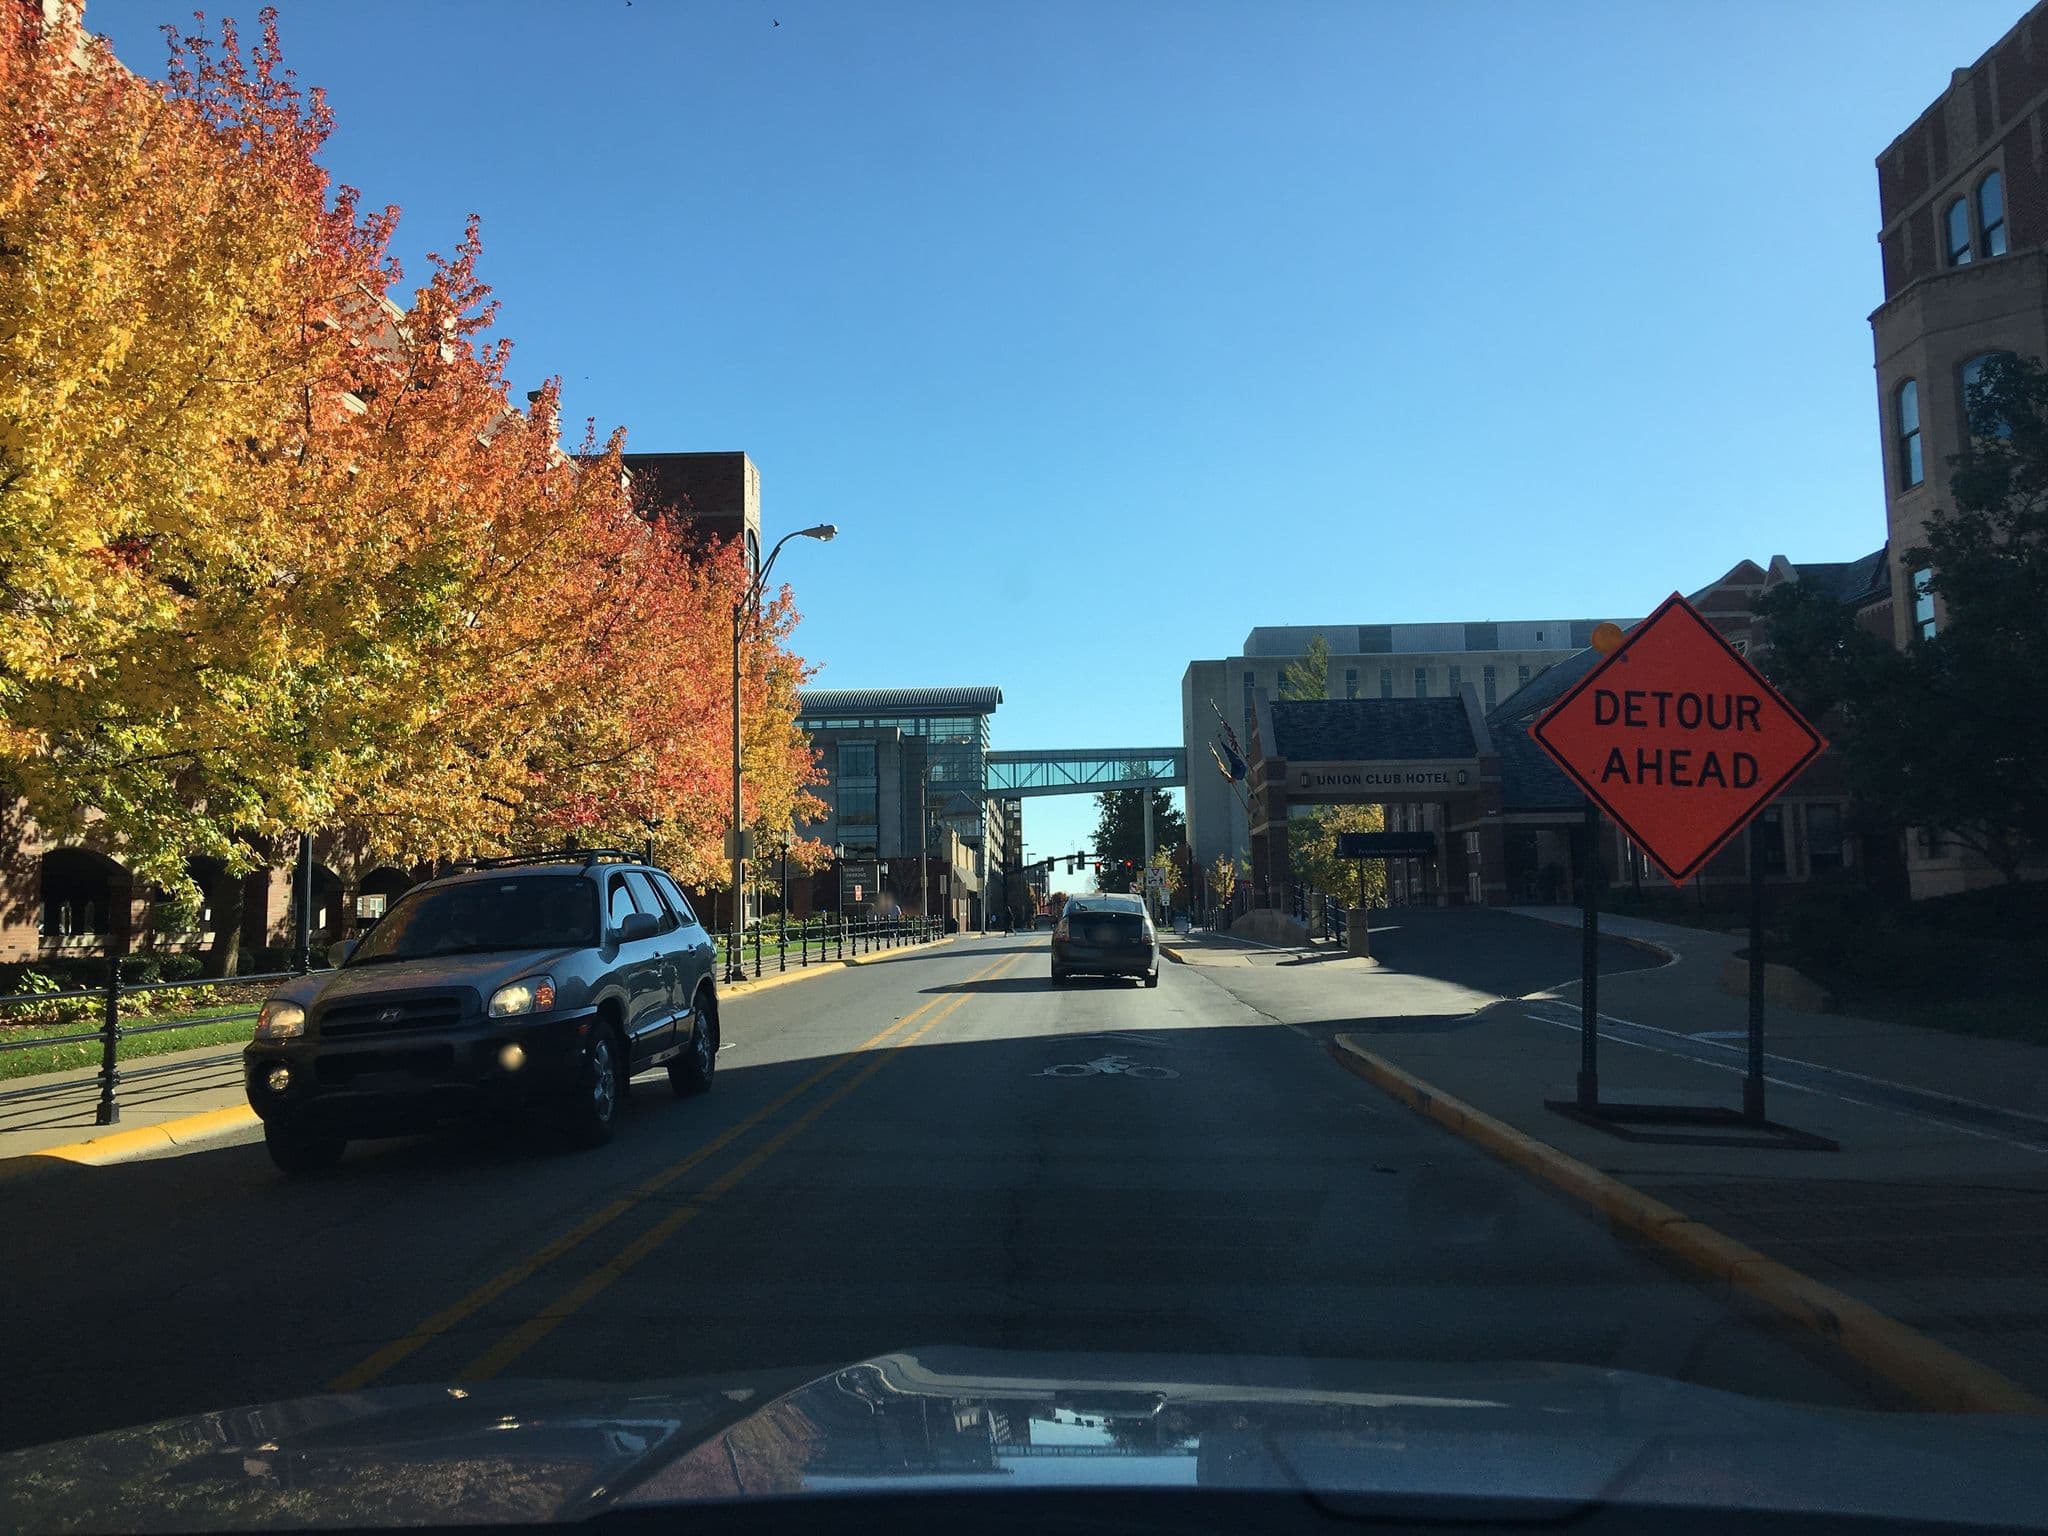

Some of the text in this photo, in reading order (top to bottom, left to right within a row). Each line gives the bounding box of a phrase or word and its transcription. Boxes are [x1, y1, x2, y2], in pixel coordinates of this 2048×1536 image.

[1594, 689, 1762, 731] DETOUR
[1317, 773, 1450, 785] UNION CLUB HOTEL
[1600, 747, 1759, 788] AHEAD
